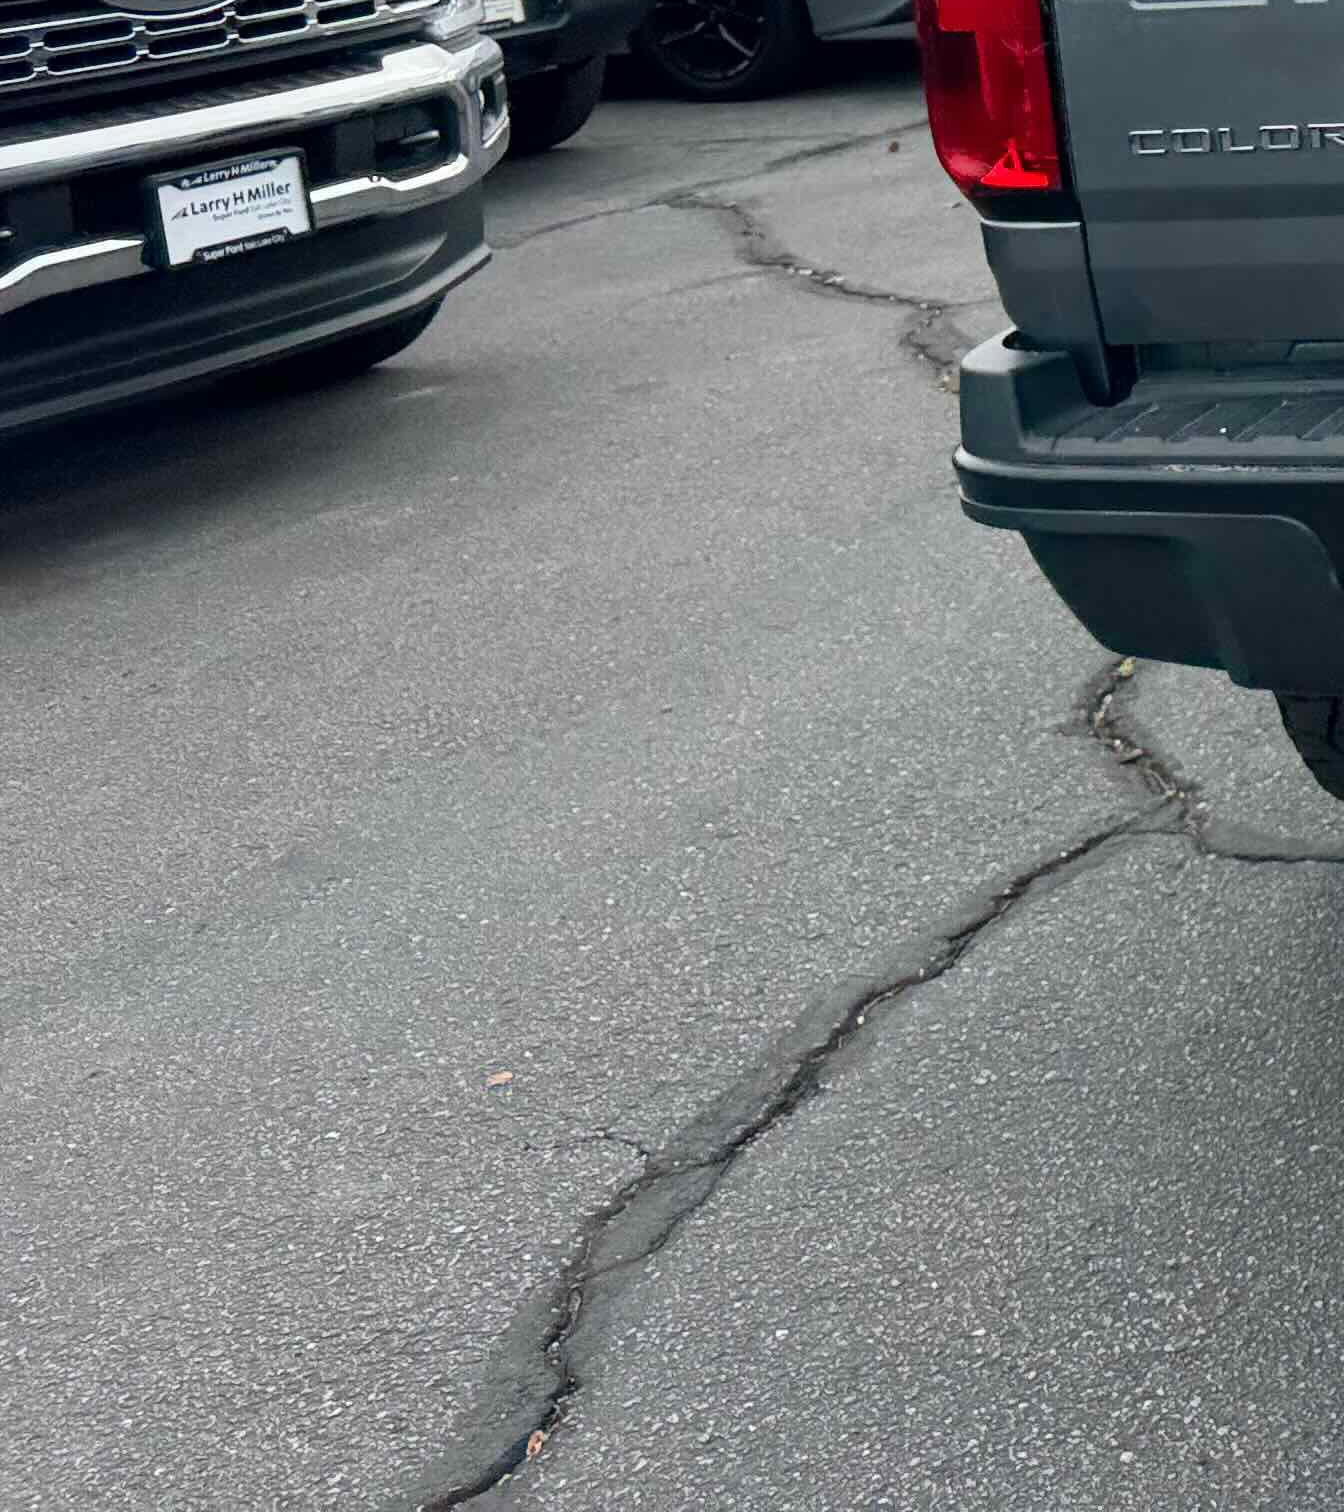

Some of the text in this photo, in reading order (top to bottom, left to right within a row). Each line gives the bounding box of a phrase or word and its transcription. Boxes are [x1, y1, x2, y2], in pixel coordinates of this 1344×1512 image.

[190, 196, 230, 215] Larry
[233, 191, 245, 206] H
[247, 181, 291, 203] Miller
